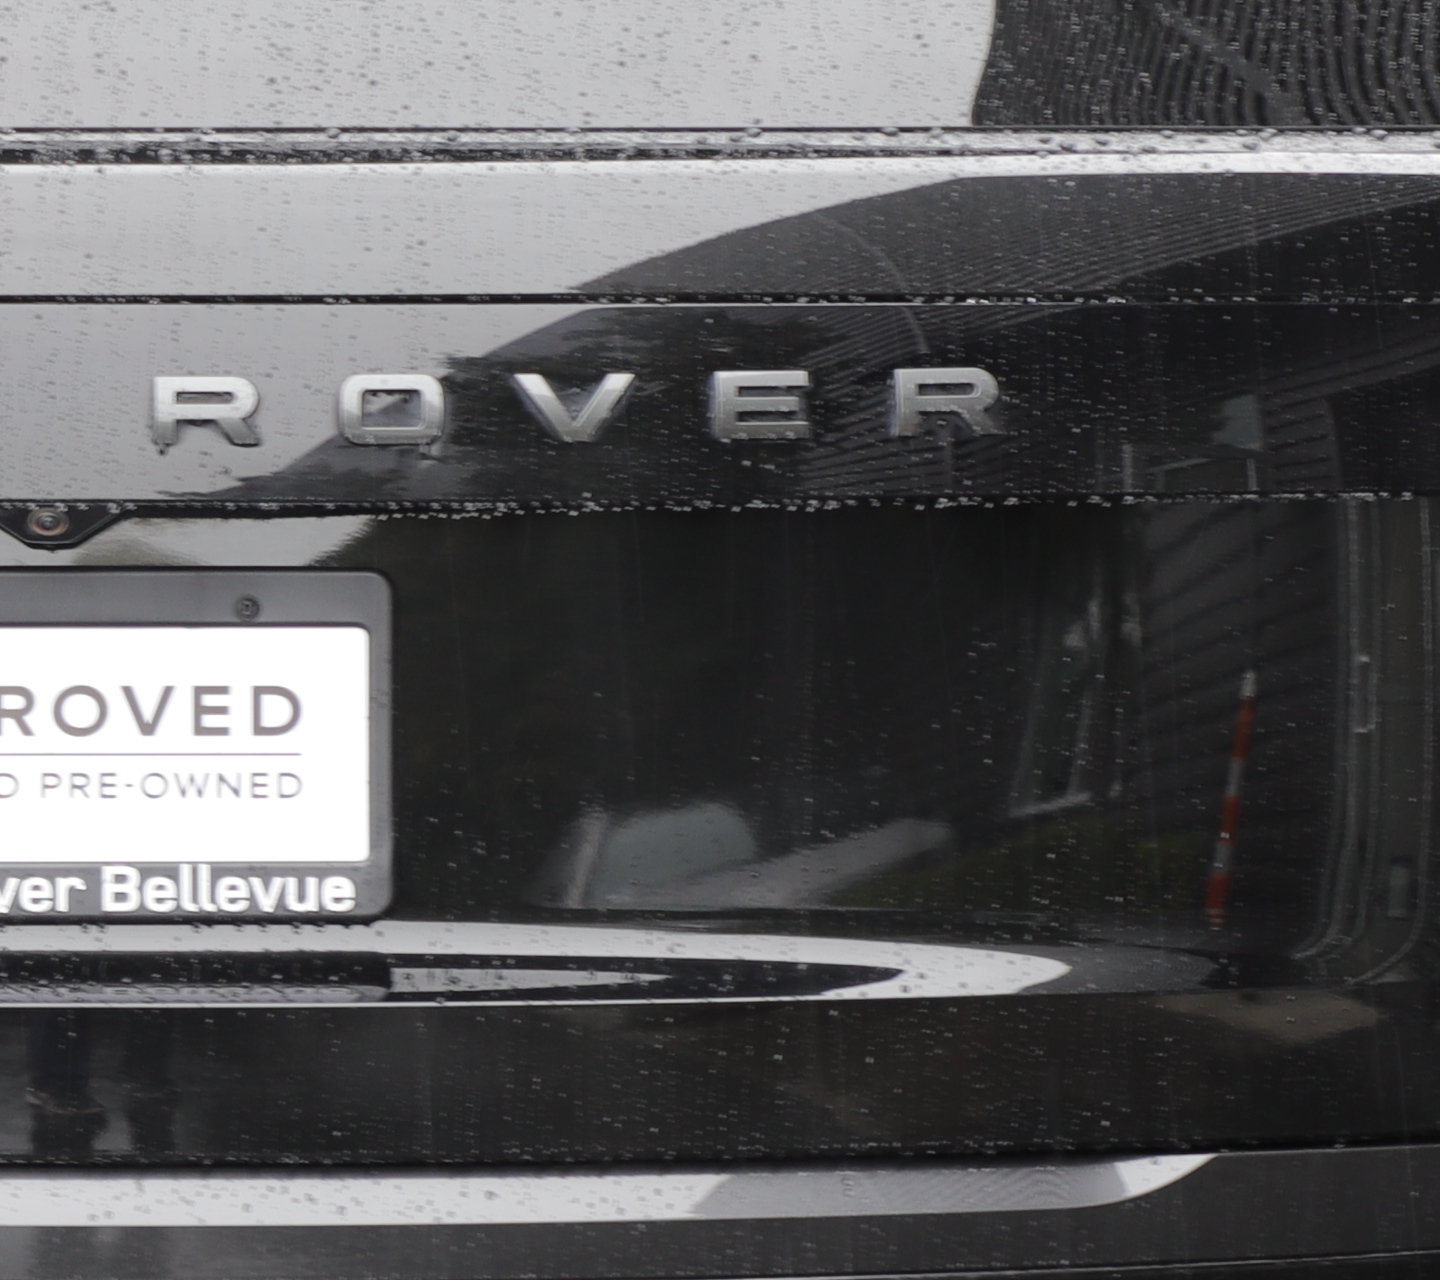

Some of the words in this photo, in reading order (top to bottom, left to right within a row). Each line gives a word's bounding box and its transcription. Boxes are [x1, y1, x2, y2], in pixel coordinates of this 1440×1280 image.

[150, 366, 1006, 449] ROVER
[39, 772, 303, 800] PRE-OWNED
[100, 864, 356, 914] Bellevue
